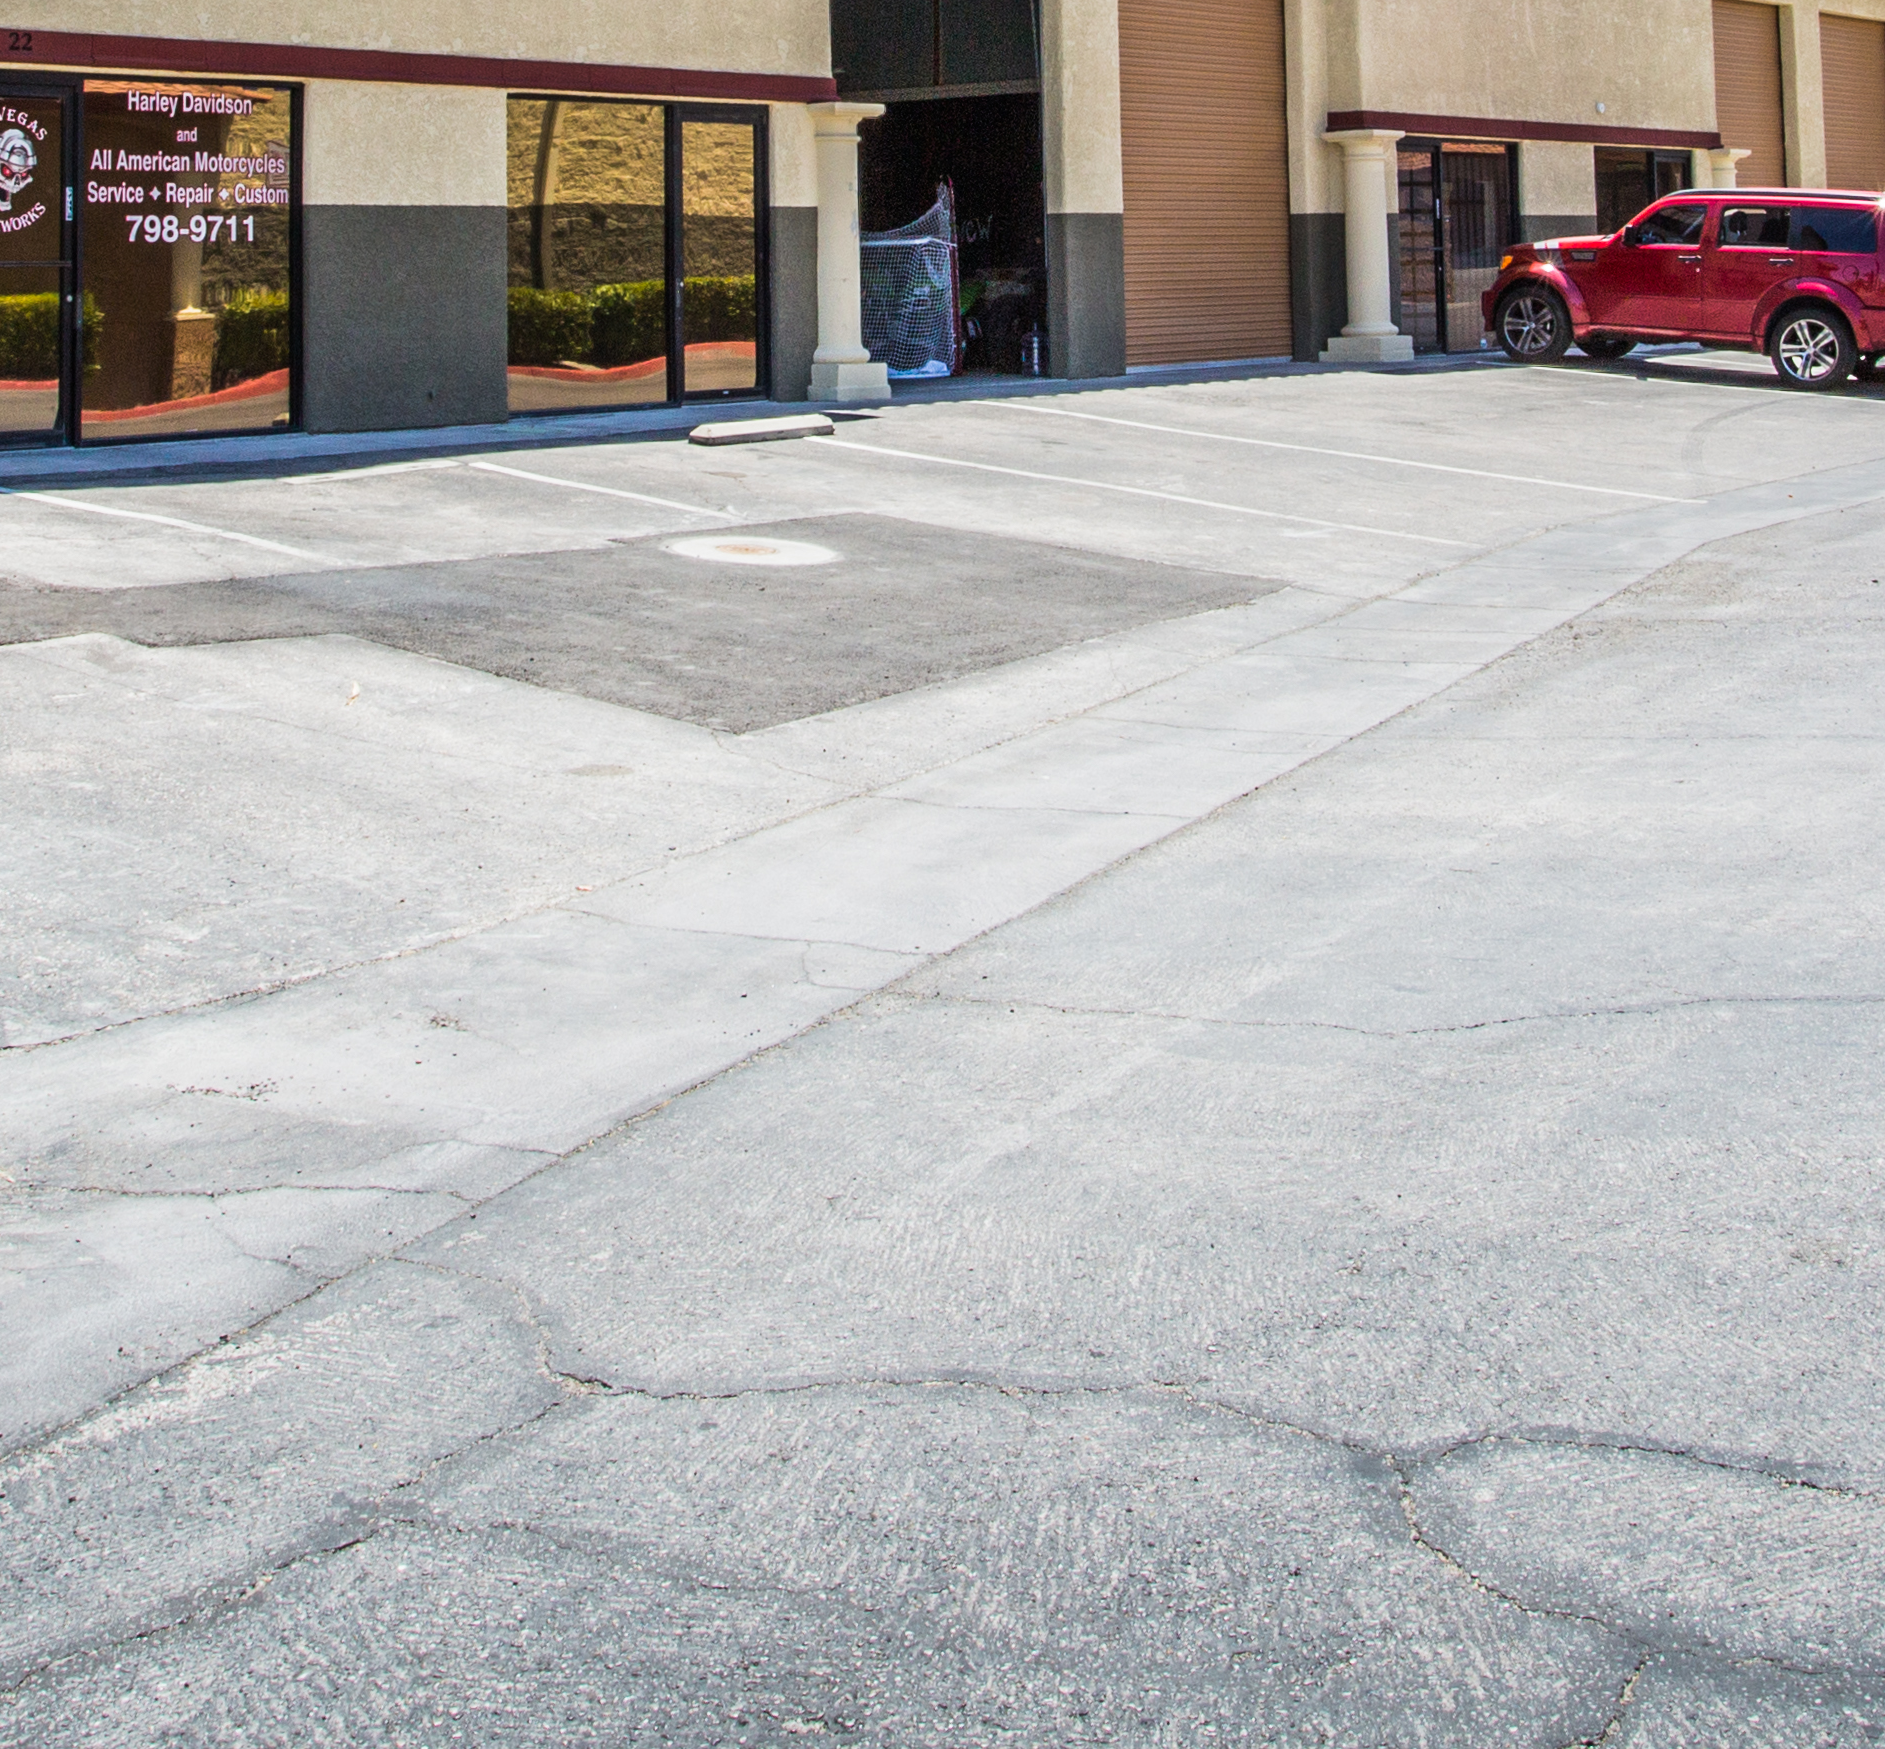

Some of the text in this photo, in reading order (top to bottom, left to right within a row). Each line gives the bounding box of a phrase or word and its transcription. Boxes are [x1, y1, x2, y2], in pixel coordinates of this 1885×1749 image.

[8, 32, 32, 51] 22
[127, 90, 252, 118] Harley Davidson
[176, 127, 198, 142] and
[90, 148, 285, 178] All American Motorcycles
[87, 181, 144, 204] Service
[165, 182, 214, 208] Repair
[234, 183, 289, 205] Custom
[125, 214, 254, 243] 798-9711
